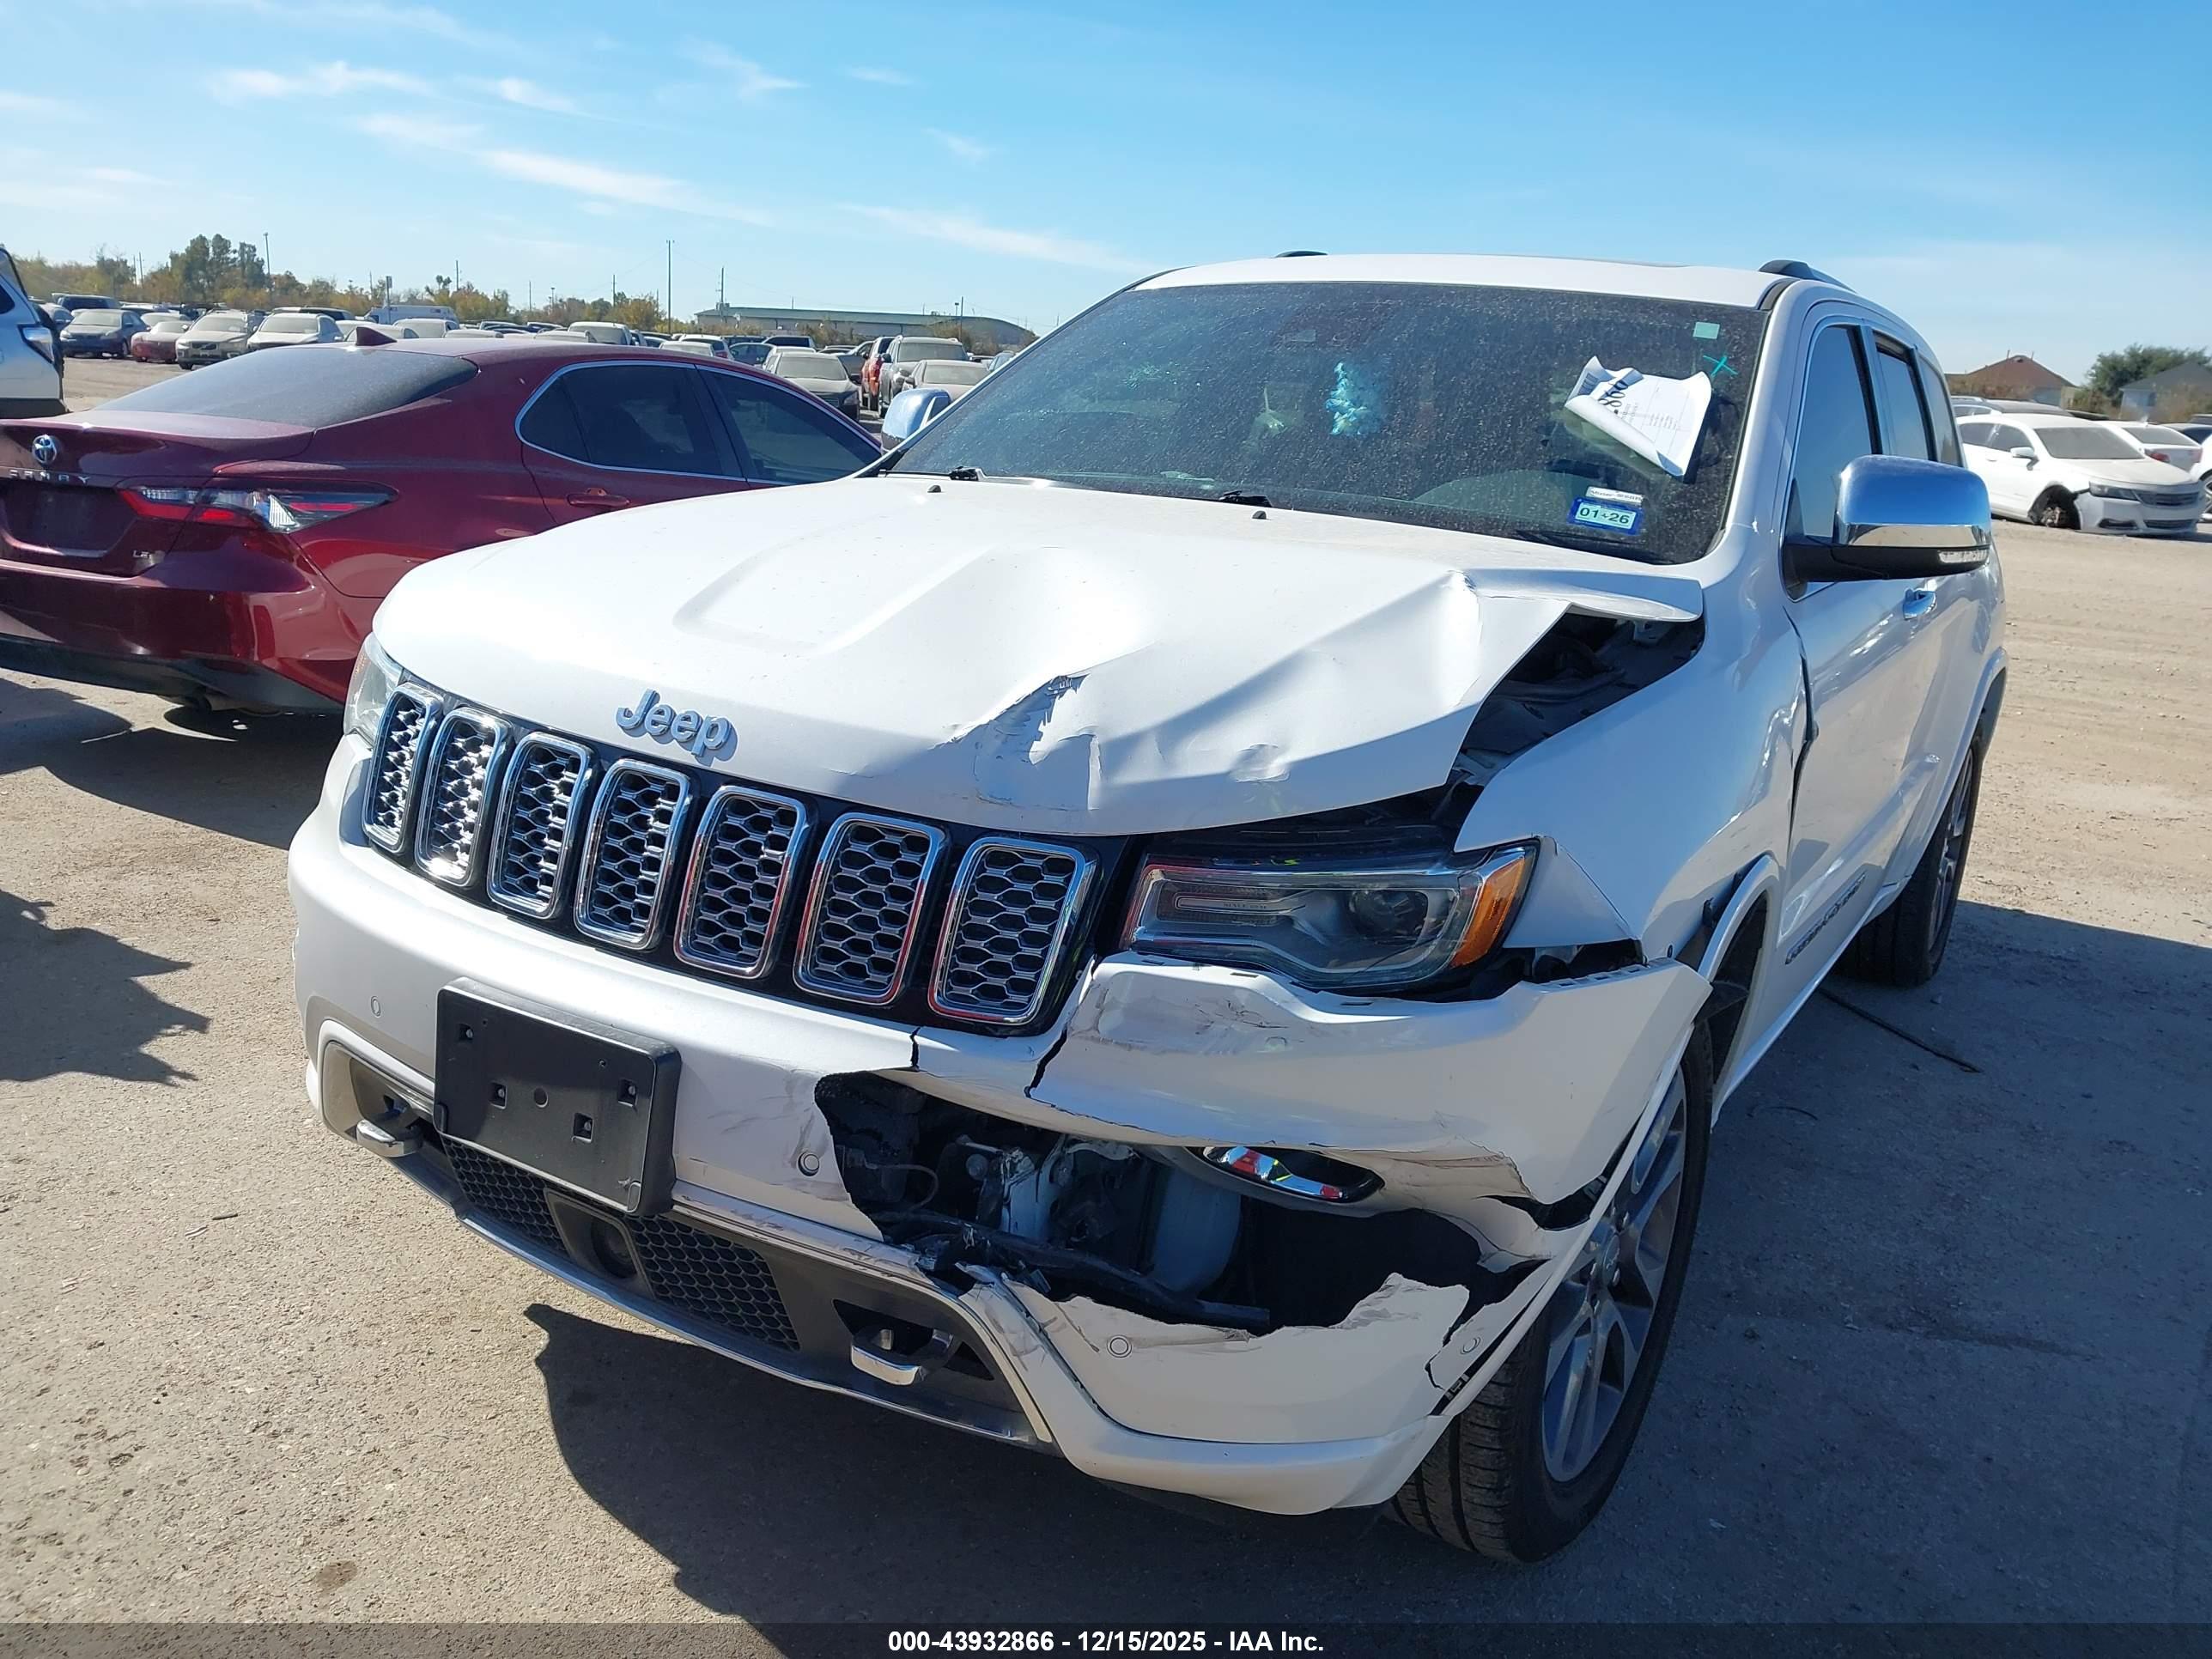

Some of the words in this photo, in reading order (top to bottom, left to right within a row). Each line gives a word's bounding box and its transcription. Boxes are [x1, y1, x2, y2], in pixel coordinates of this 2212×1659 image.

[1580, 507, 1599, 518] 01
[1607, 513, 1631, 524] 26
[616, 688, 734, 759] Jeep
